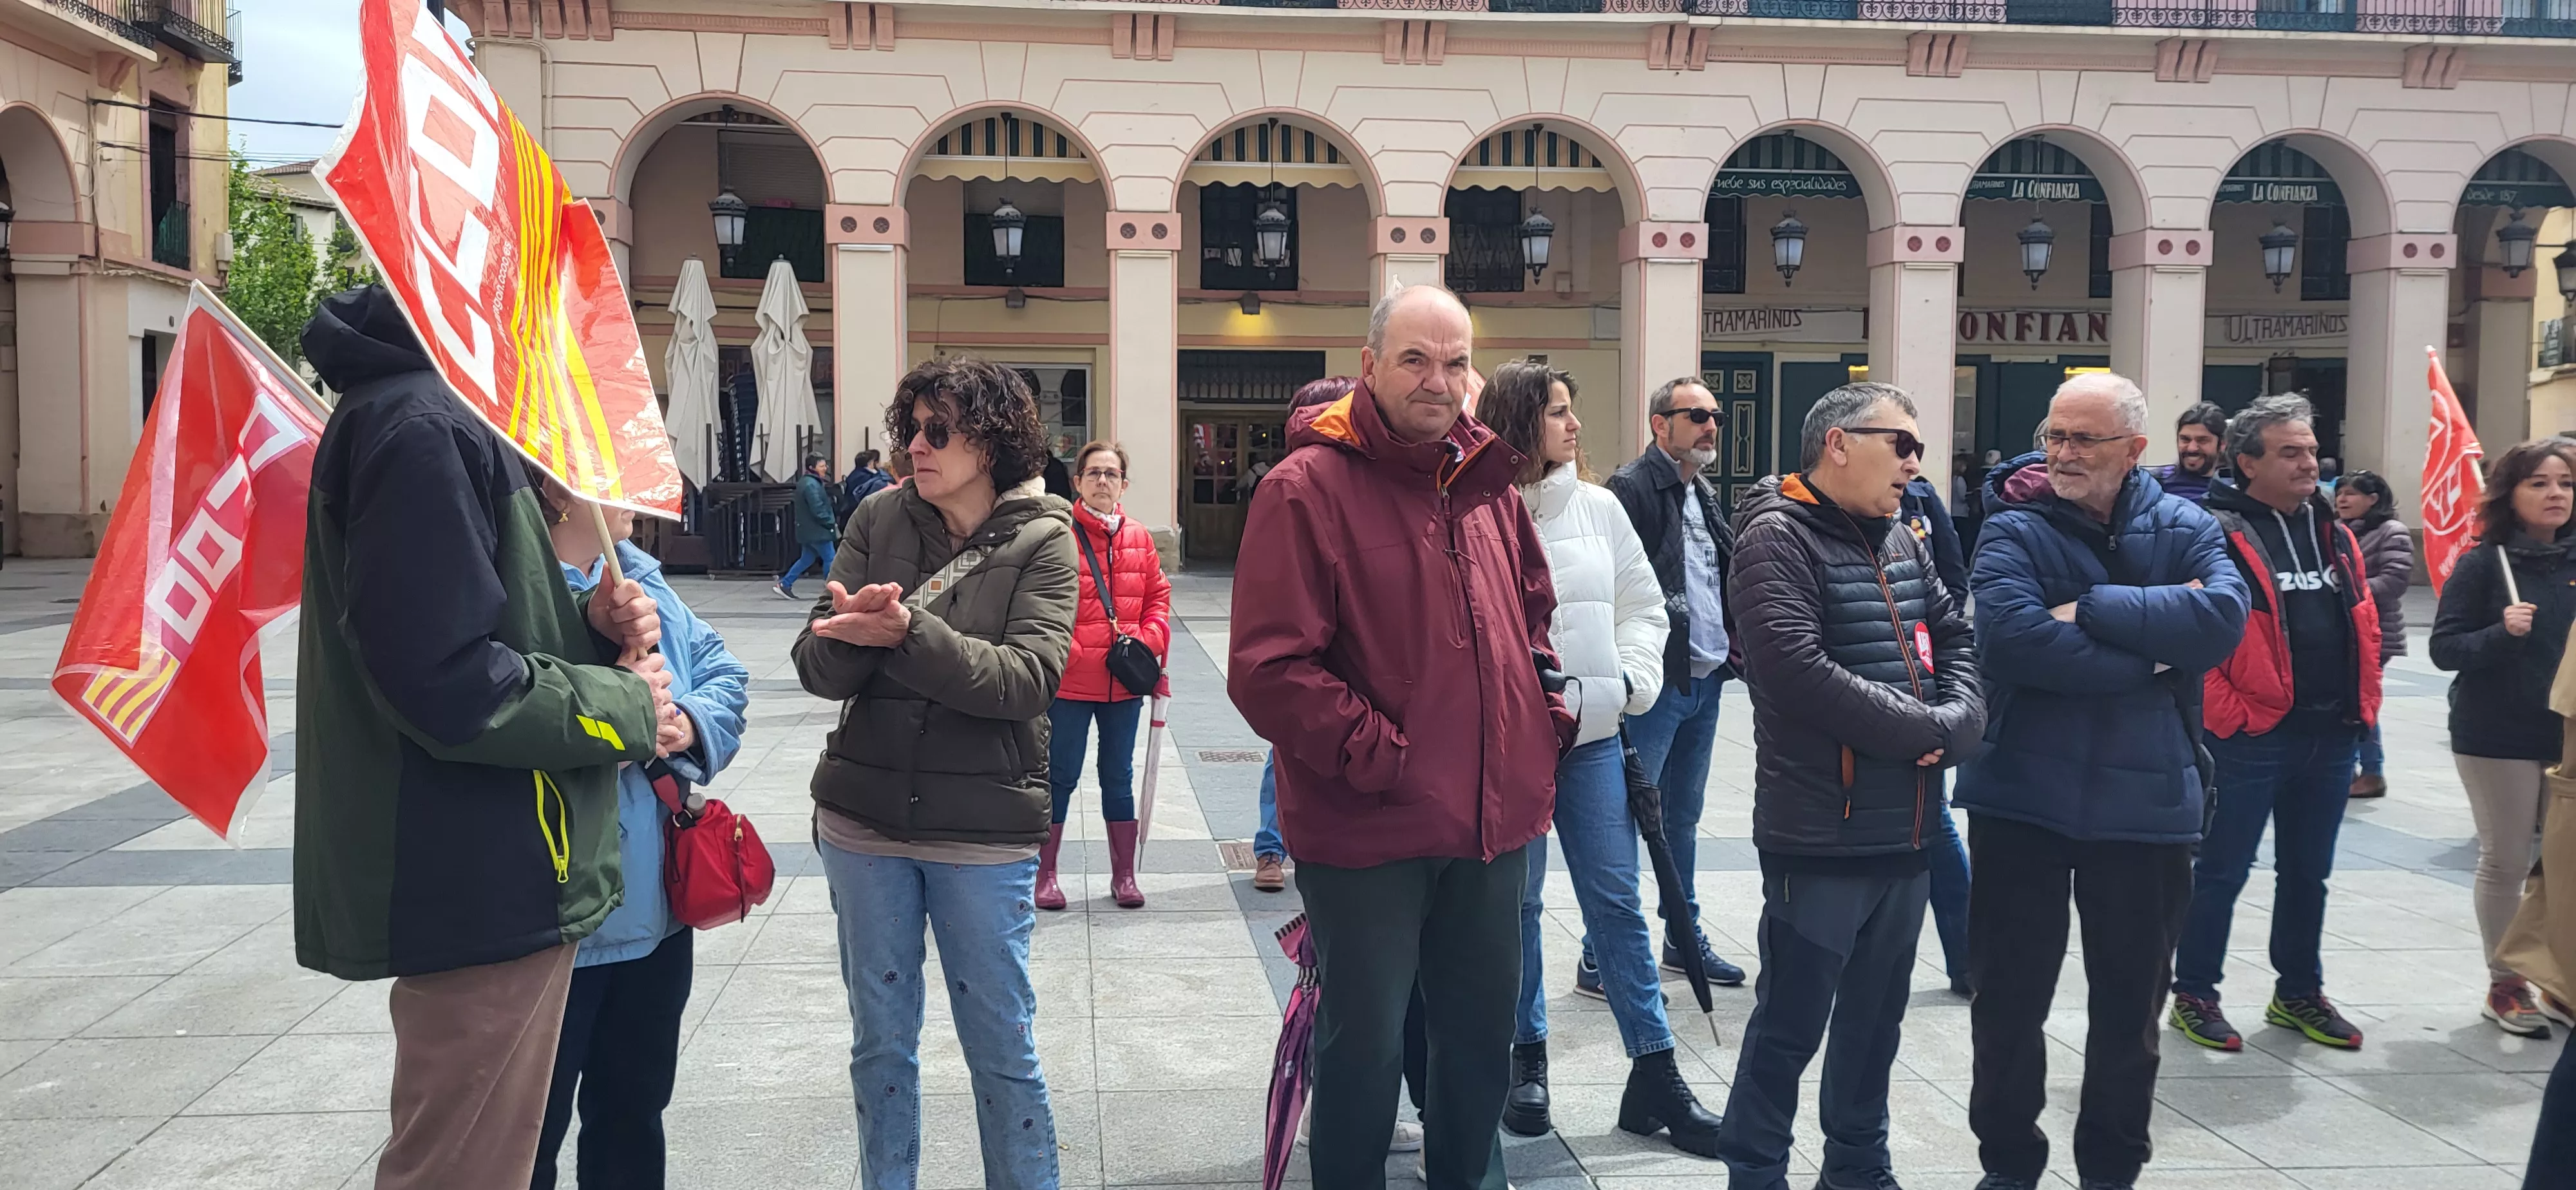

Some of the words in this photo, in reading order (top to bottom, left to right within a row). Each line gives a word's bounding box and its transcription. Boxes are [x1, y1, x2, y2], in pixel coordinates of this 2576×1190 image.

[1747, 179, 1766, 189] sus
[1771, 176, 1847, 194] especialidades
[2011, 180, 2025, 198] LA
[2028, 180, 2080, 198] CONFIANZA
[2252, 183, 2264, 200] LA
[2267, 183, 2318, 201] CONFIANZA
[1703, 309, 1803, 334] TRAMARINOS
[2228, 315, 2349, 343] ULTRAMARINOS
